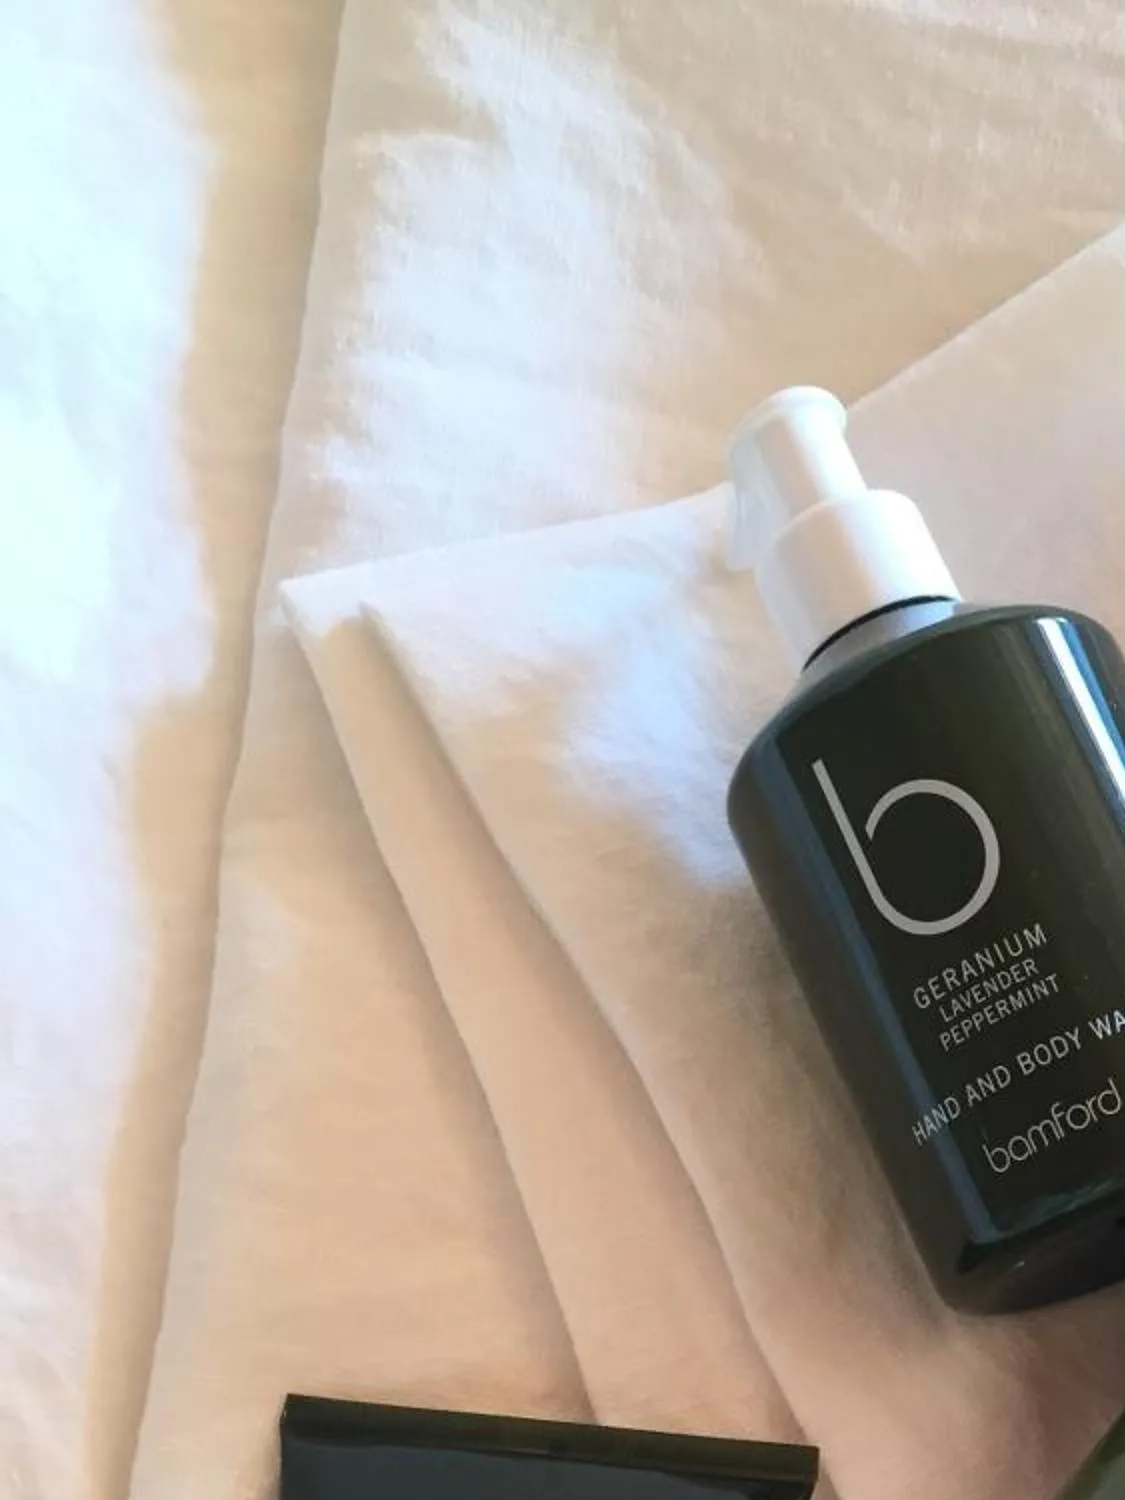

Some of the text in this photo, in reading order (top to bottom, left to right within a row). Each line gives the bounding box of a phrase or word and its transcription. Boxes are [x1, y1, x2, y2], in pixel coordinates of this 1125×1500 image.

[812, 759, 999, 935] b
[912, 923, 1048, 1010] GERANIUM
[939, 958, 1038, 1022] LAVENDER
[939, 974, 1060, 1052] PEPPERMINT
[912, 1096, 961, 1146] HAND
[965, 1065, 1012, 1107] AND
[1016, 1027, 1083, 1076] BODY
[982, 1079, 1123, 1173] bamford
